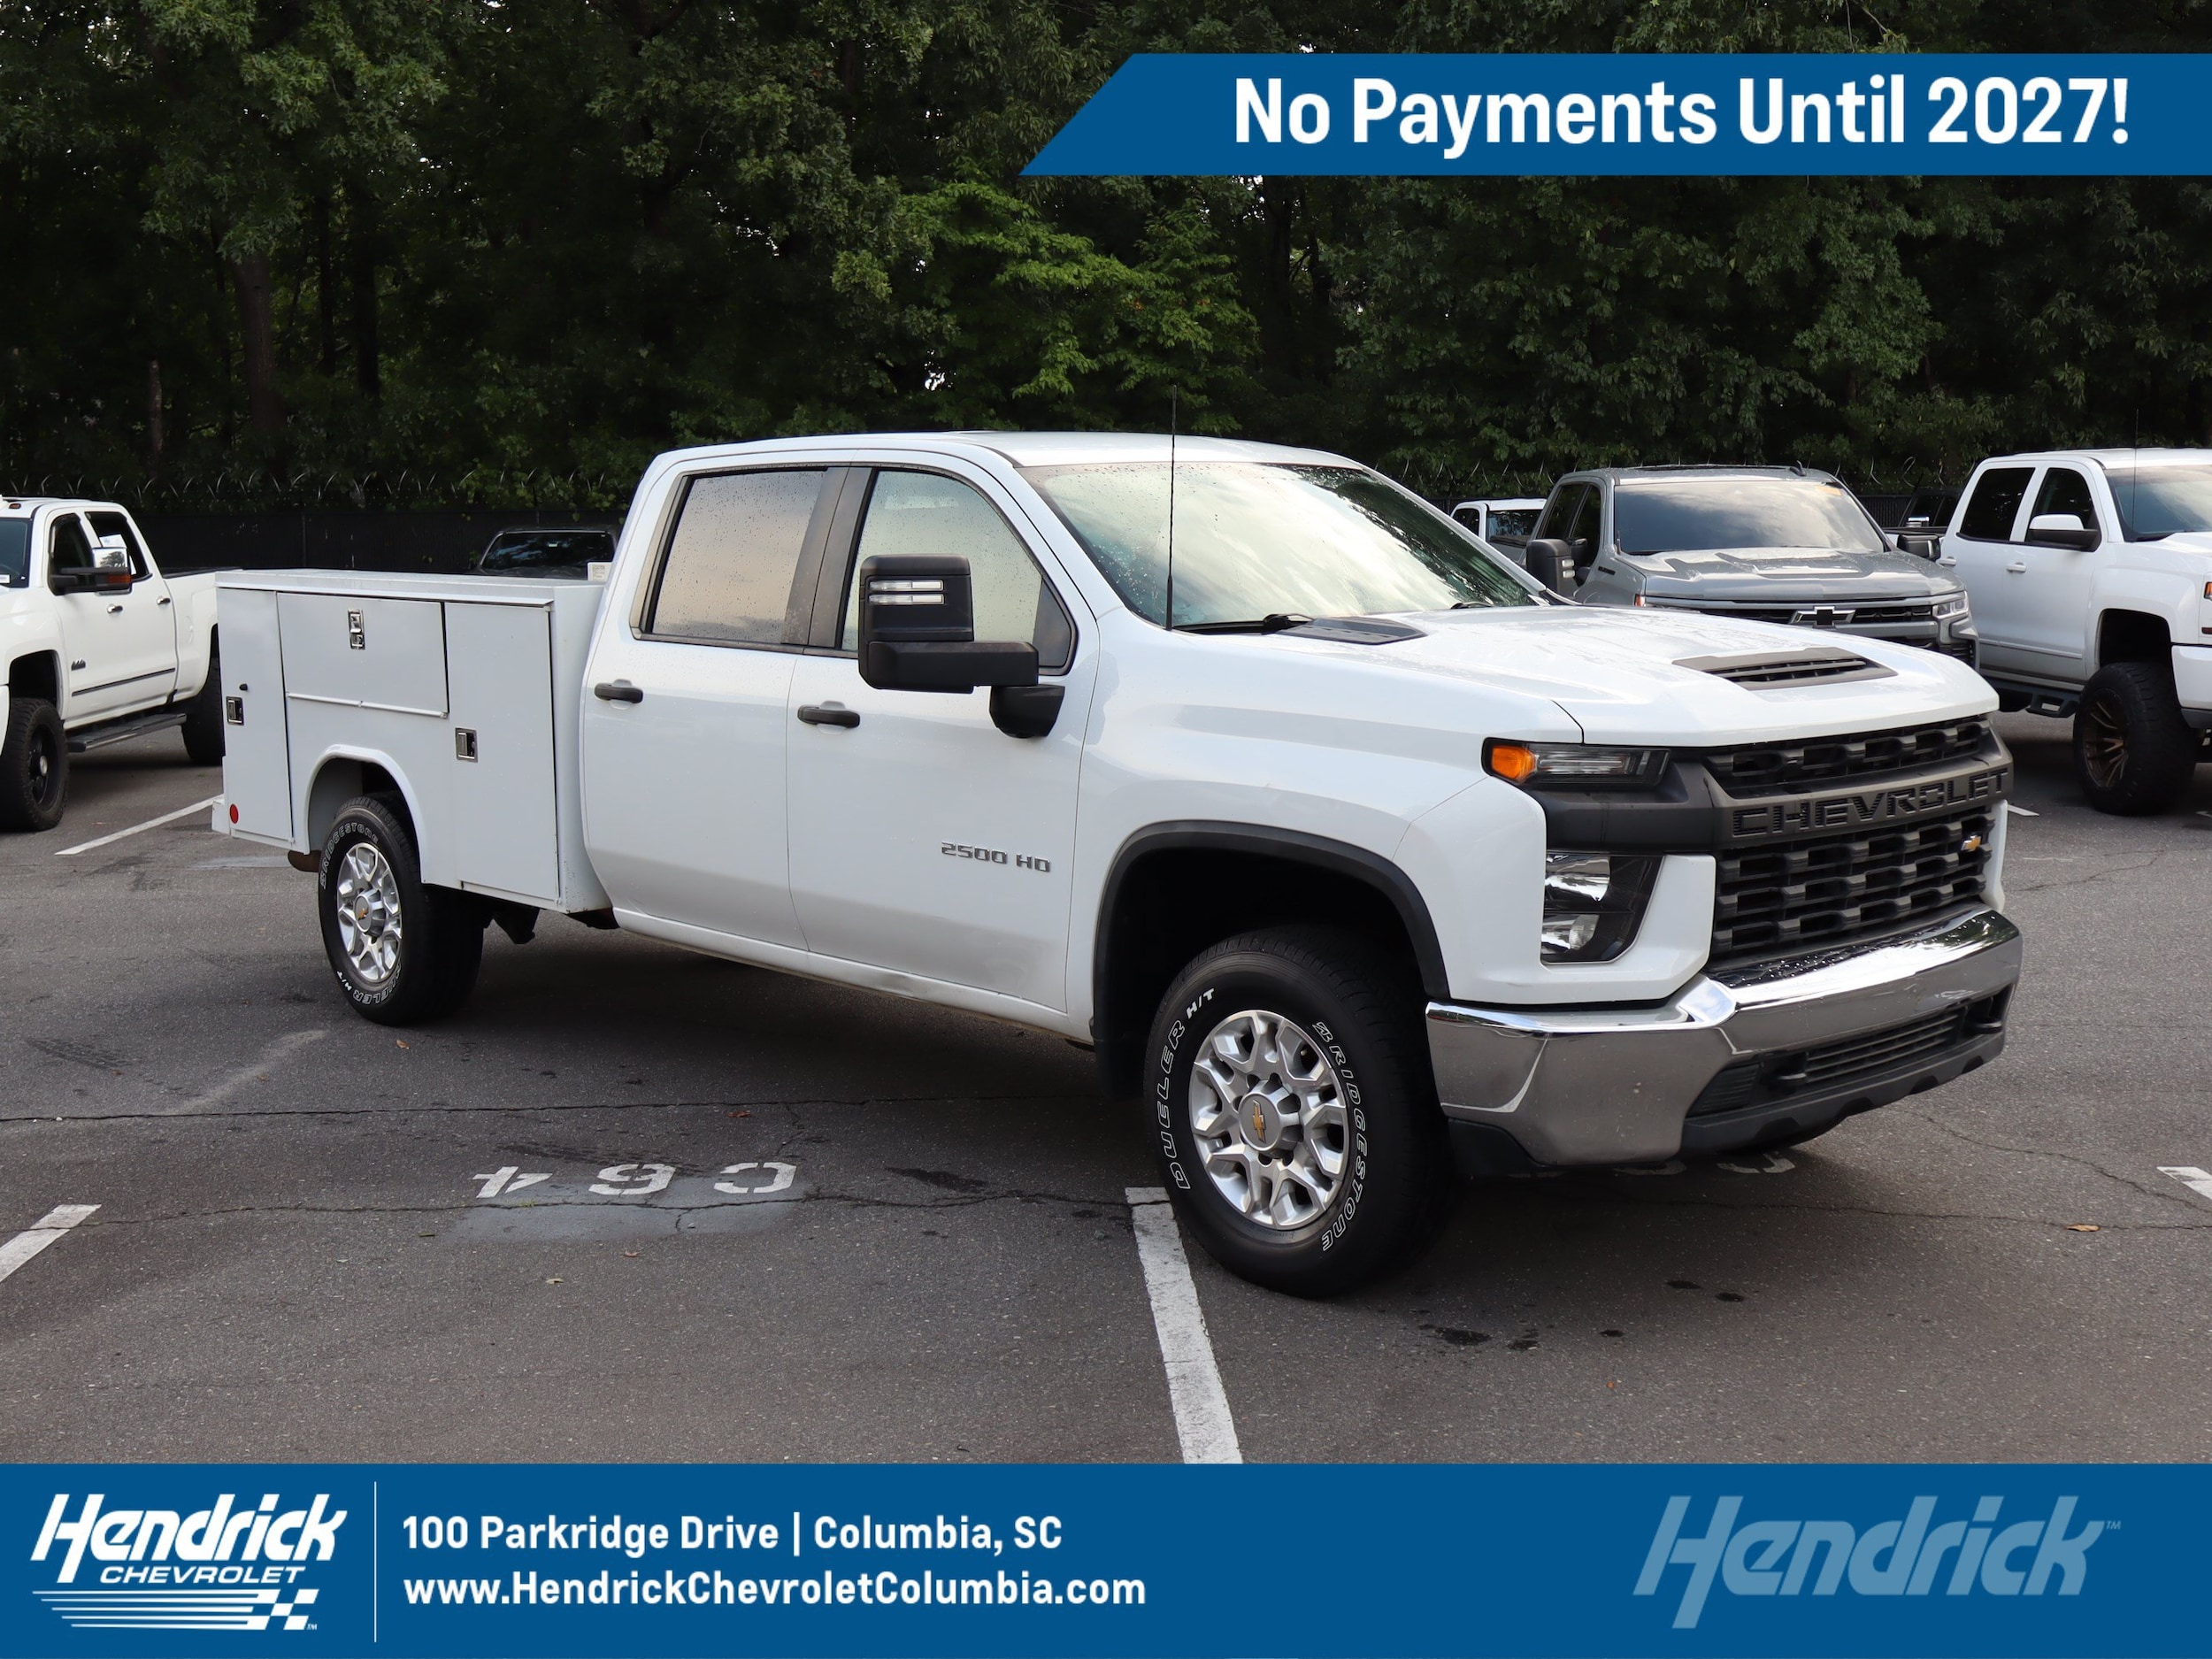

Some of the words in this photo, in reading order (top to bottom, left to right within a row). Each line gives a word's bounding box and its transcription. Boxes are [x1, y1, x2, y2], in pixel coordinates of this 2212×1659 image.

[941, 841, 1008, 864] 2500
[1016, 852, 1051, 872] HD
[1732, 767, 2008, 838] CHEVROLET
[1156, 1019, 1191, 1190] DUELER
[1186, 987, 1216, 1019] H/T
[1312, 1021, 1369, 1252] BRIDGESTONE
